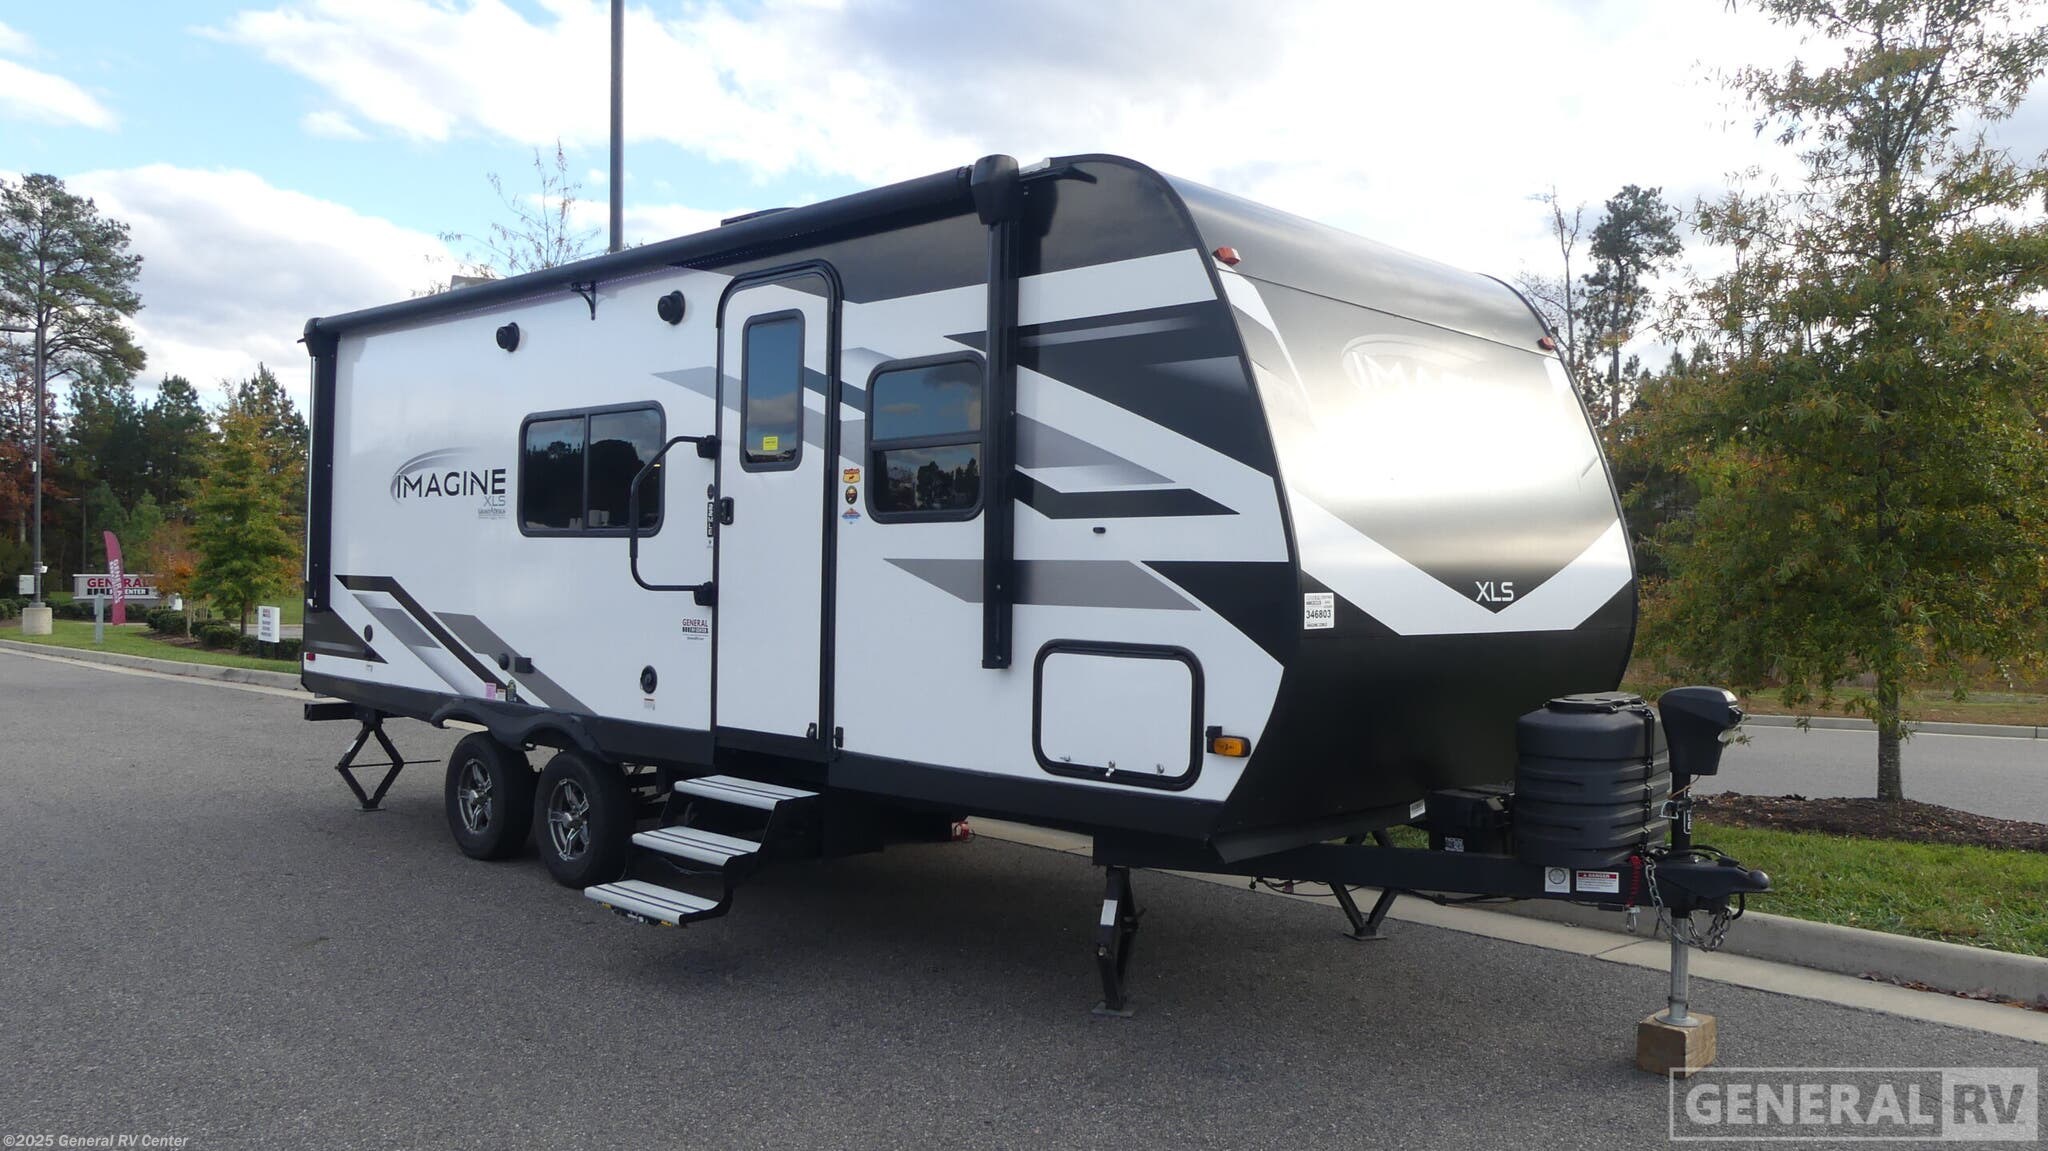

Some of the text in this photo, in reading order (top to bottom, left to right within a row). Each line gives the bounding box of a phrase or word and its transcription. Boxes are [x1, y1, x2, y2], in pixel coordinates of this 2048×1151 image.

[397, 468, 506, 499] IMAGINE
[483, 495, 506, 507] XLS
[1475, 581, 1514, 602] XLS
[1306, 609, 1331, 619] 346803
[682, 618, 708, 627] GENERAL
